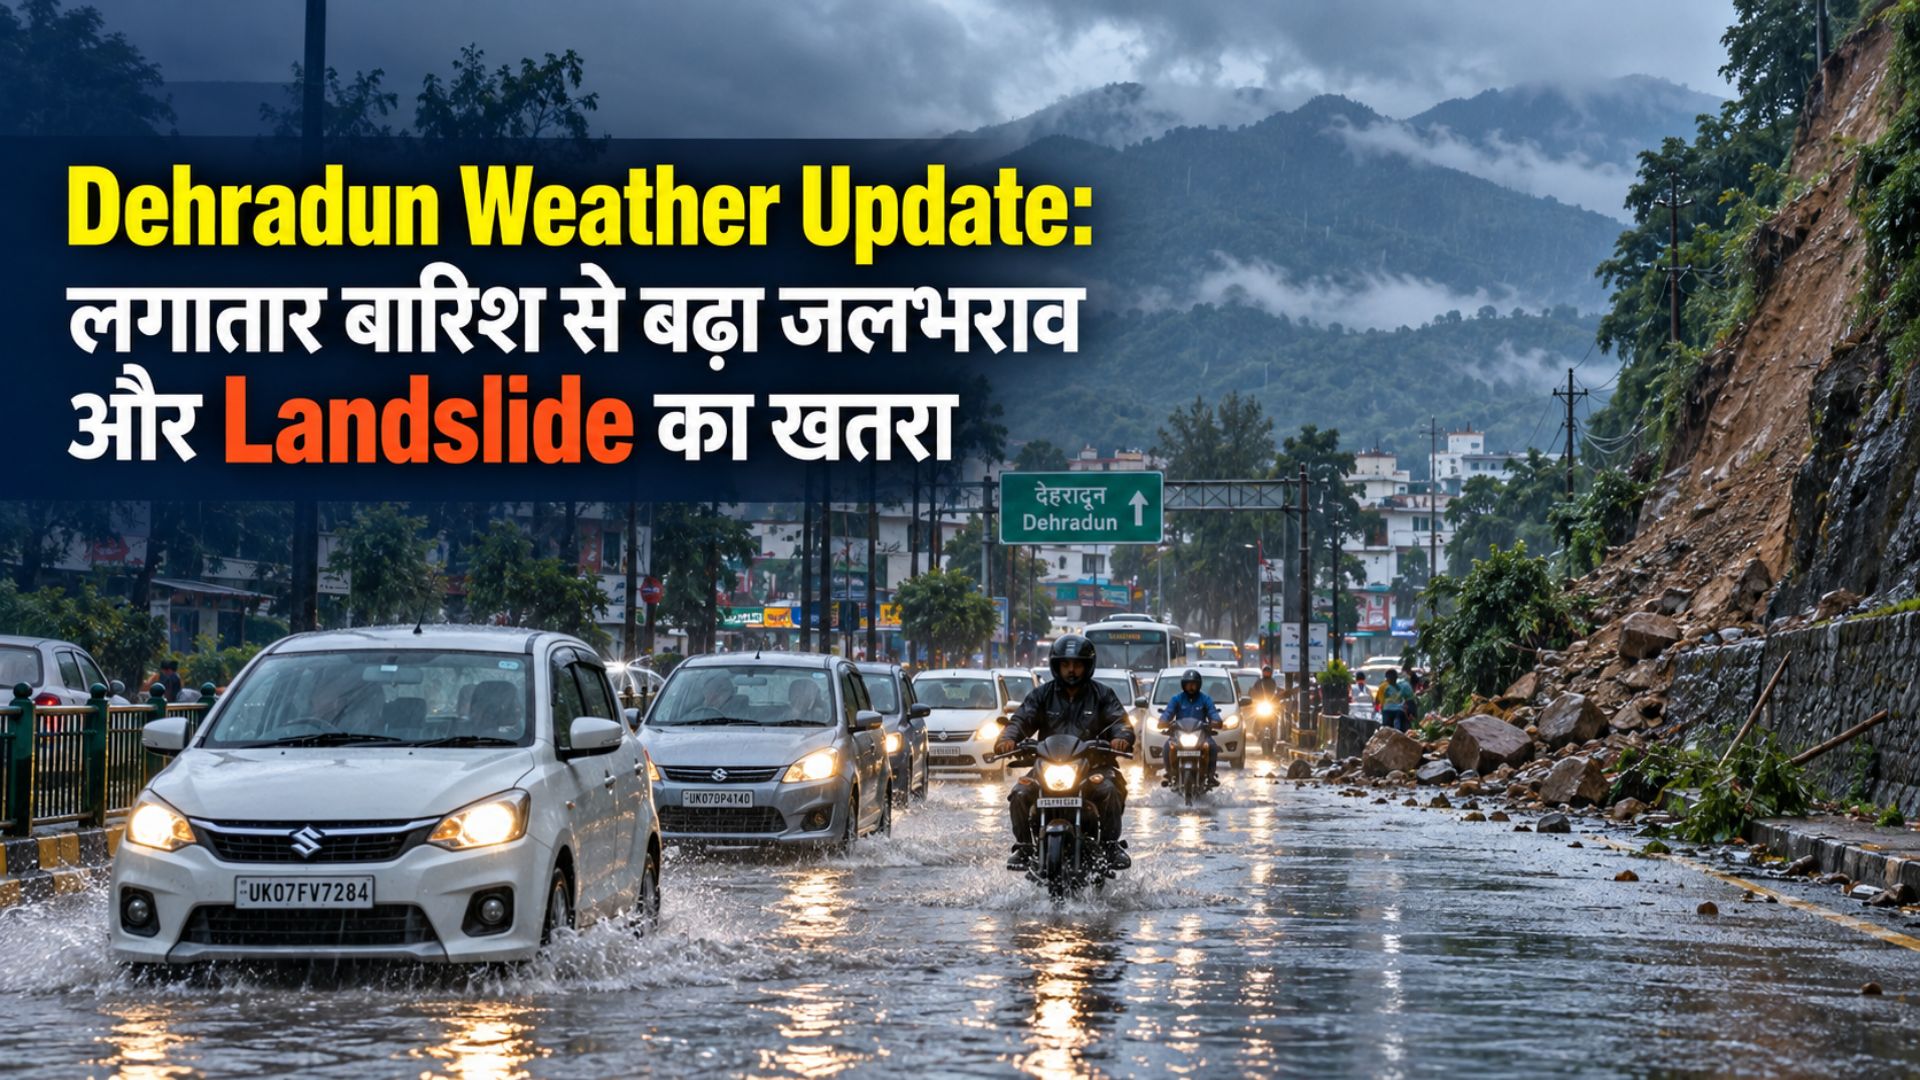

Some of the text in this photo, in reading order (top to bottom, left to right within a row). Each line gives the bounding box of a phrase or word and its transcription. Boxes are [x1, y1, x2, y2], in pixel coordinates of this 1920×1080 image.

[1034, 481, 1107, 510] देहरादून
[1023, 513, 1117, 531] Dehradun
[249, 882, 368, 902] UK07FV7284
